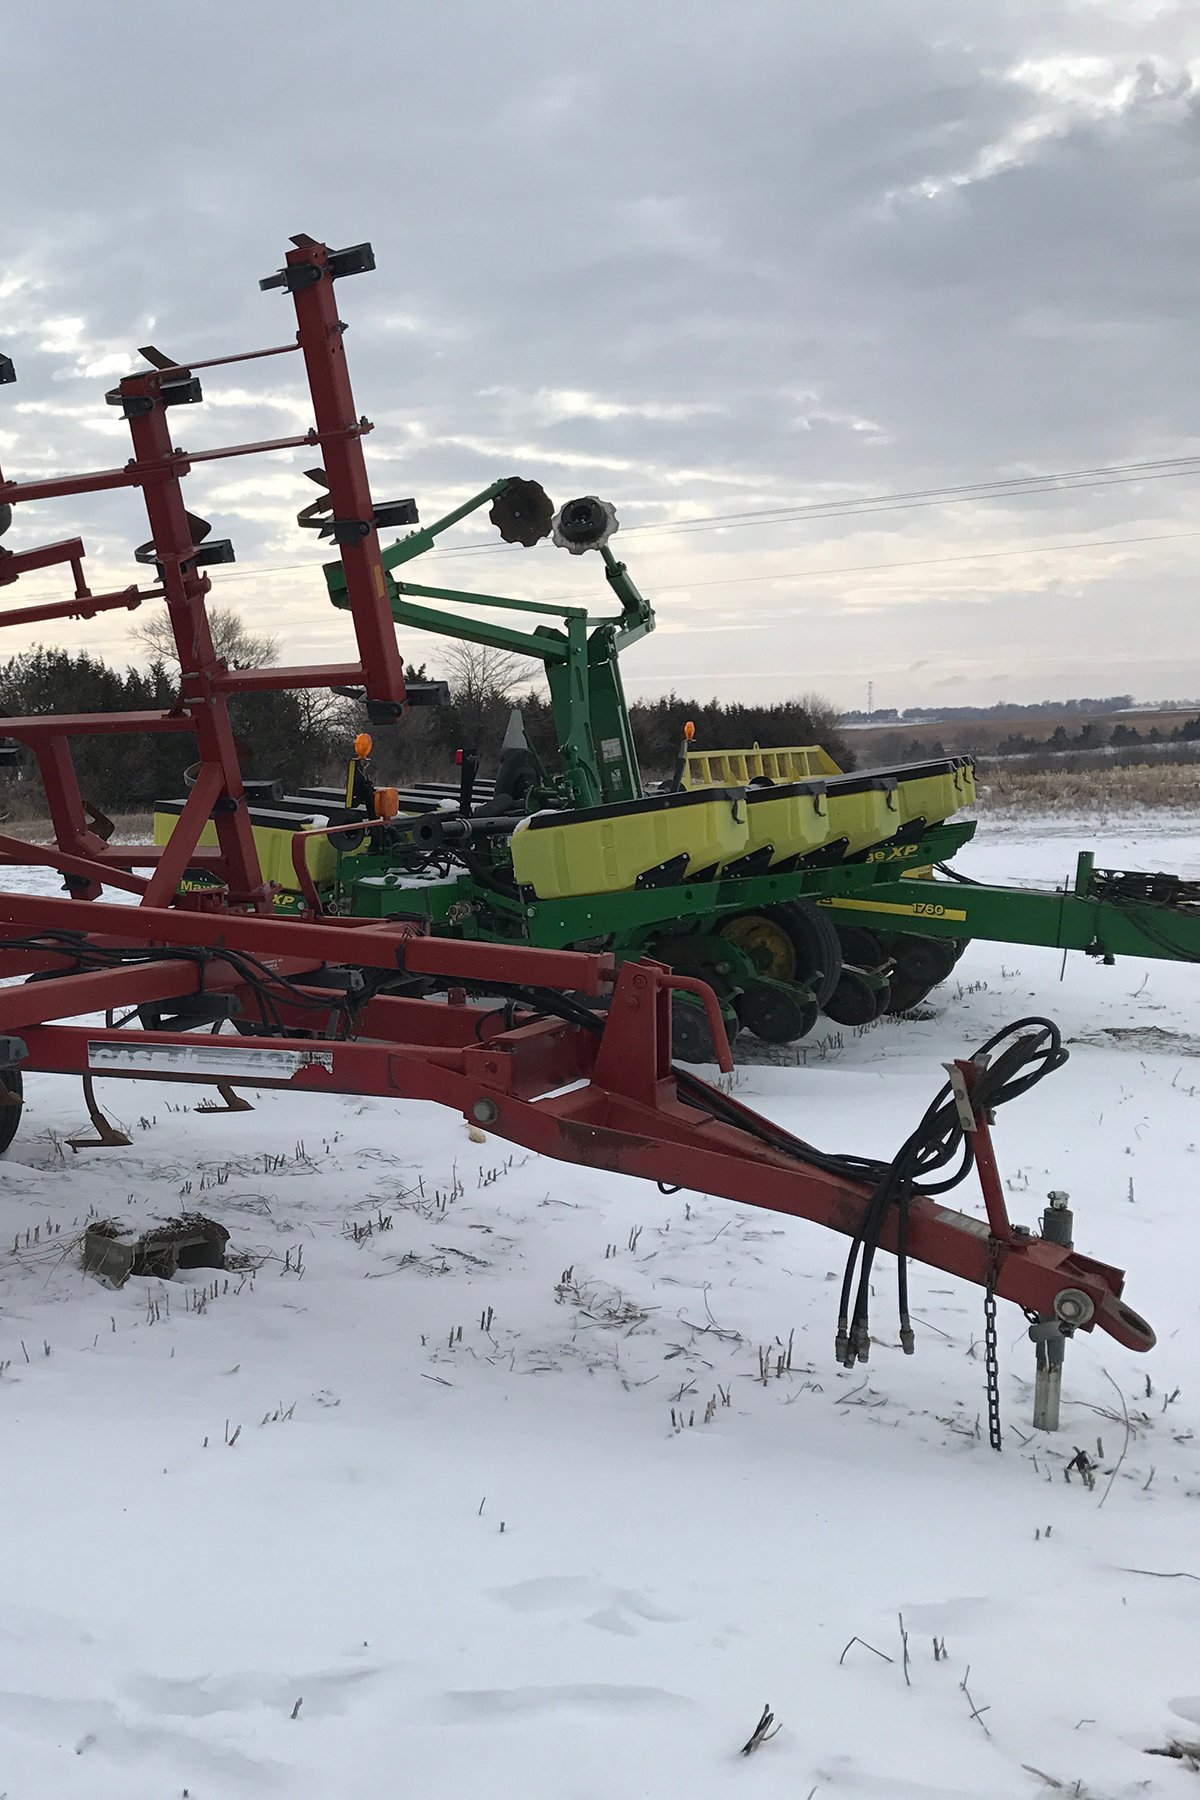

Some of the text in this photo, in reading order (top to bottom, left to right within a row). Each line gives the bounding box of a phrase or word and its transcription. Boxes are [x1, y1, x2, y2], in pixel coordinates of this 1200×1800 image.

[865, 844, 919, 864] ge XP
[272, 893, 295, 905] XP
[912, 902, 944, 915] 1760
